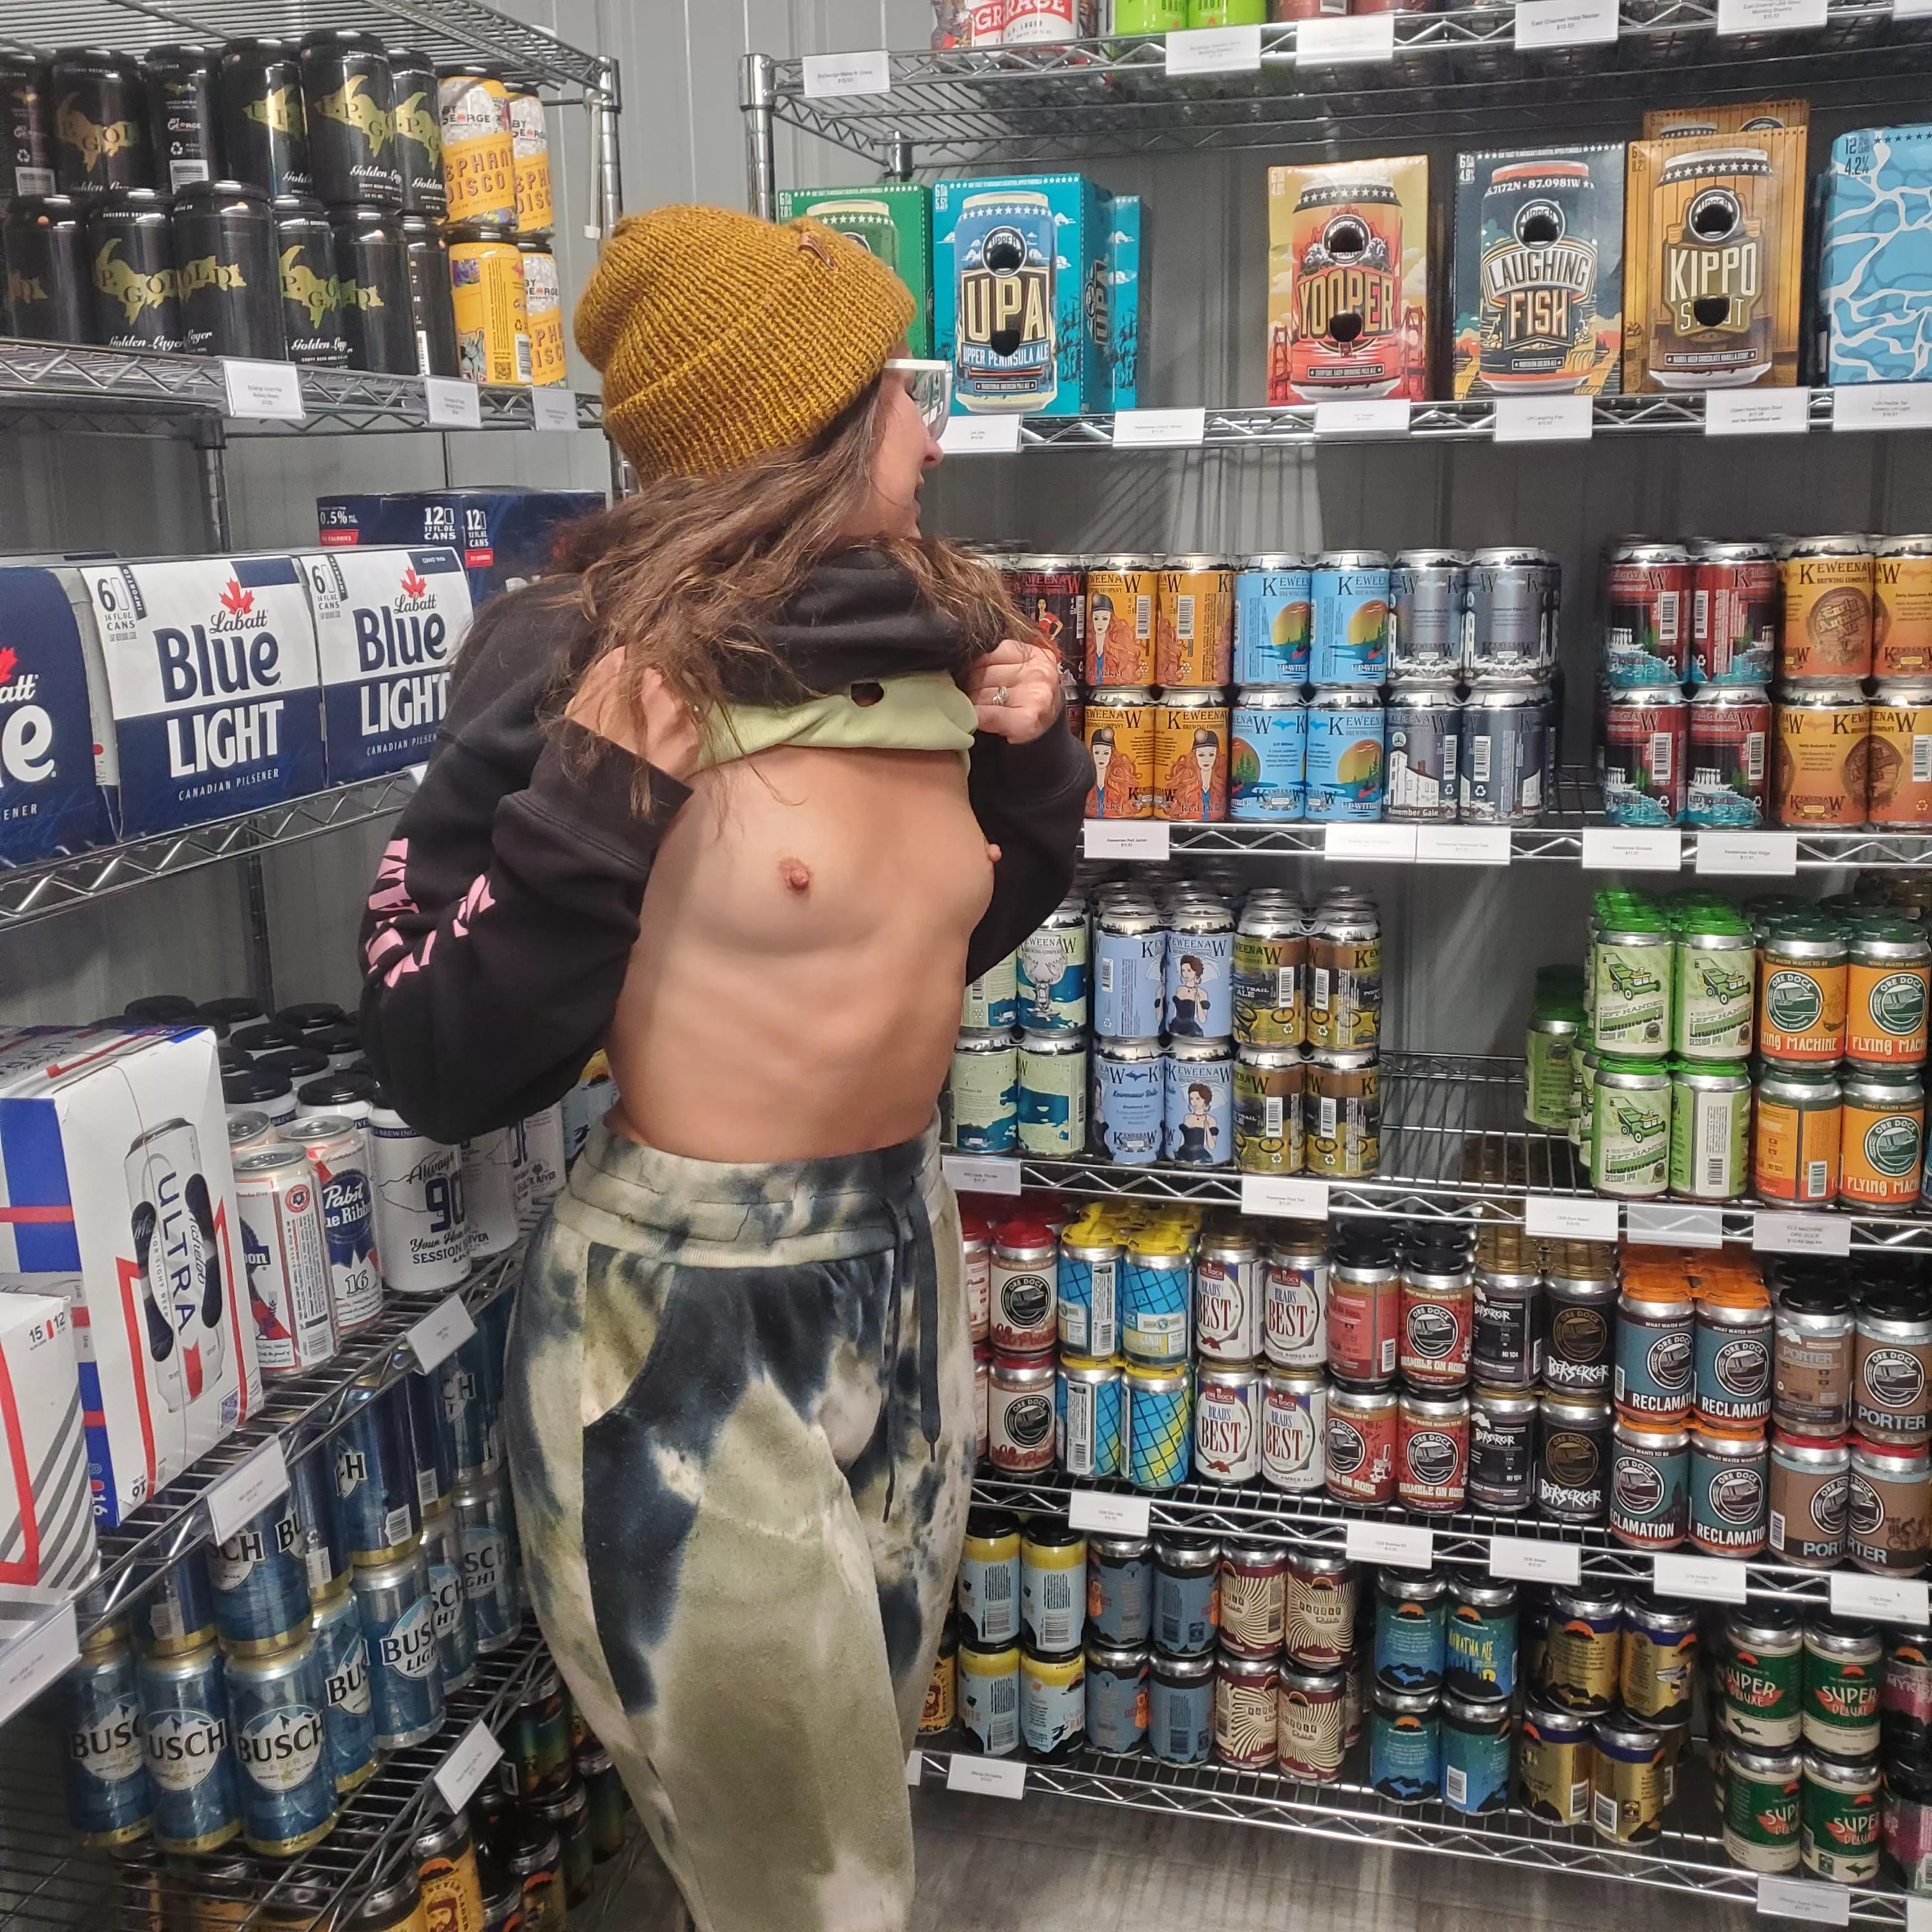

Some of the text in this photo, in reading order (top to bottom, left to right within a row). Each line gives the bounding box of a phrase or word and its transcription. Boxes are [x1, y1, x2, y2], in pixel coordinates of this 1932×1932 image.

[1632, 146, 1637, 158] 6
[1846, 137, 1857, 154] 12
[1460, 155, 1465, 168] 6
[1845, 157, 1869, 175] 4.2%
[350, 165, 387, 176] Golden
[413, 177, 442, 190] Golden
[935, 184, 940, 197] 6
[1528, 179, 1580, 189] 87.0981W
[1488, 250, 1591, 291] LAUGHING
[1670, 243, 1756, 302] KIPPO
[967, 275, 1046, 342] UPA
[1300, 270, 1393, 335] YOOPER
[1510, 289, 1567, 341] FISH
[291, 338, 330, 351] Golden
[963, 344, 1049, 368] UPPER PENINSULA ALE
[424, 507, 444, 526] 12
[466, 509, 481, 531] 12
[470, 539, 489, 548] CANS
[312, 565, 325, 594] 6
[1799, 563, 1873, 584] KEWEENA
[97, 578, 116, 611] 6
[319, 601, 339, 610] CANS
[394, 593, 436, 614] Labatt
[107, 620, 135, 631] CANS
[209, 610, 268, 633] Labatt
[353, 606, 447, 673] Blue
[153, 624, 281, 703] Blue
[360, 673, 450, 737] LIGHT
[1168, 710, 1228, 730] KEWEENA
[167, 700, 284, 779] LIGHT
[366, 740, 408, 758] CANADIAN
[178, 768, 280, 801] CANADIAN PILSENER
[1181, 804, 1200, 813] Red
[1388, 808, 1439, 816] November Gale
[1772, 975, 1814, 990] ORE DOCK
[1881, 977, 1922, 991] ORE DOCK
[1236, 989, 1255, 998] ALE
[1623, 1000, 1664, 1015] HANDED
[1617, 1030, 1625, 1039] IPA
[1712, 1036, 1721, 1045] IPA
[1787, 1037, 1837, 1051] MACHINE
[1853, 1036, 1892, 1055] FLYING
[1168, 1064, 1231, 1083] KEWEENAW
[1876, 1120, 1916, 1134] ORE DOCK
[537, 1171, 556, 1183] RIVER
[1627, 1172, 1636, 1180] IPA
[323, 1181, 364, 1209] Pabst
[1848, 1176, 1887, 1197] FLYING
[425, 1170, 465, 1233] 90
[326, 1202, 370, 1228] ue Ribb
[158, 1171, 196, 1336] ULTRA
[410, 1238, 440, 1252] Your
[155, 1258, 164, 1289] LIGHT
[345, 1270, 369, 1295] 16
[1009, 1278, 1044, 1290] ORE DOCK
[1197, 1292, 1231, 1330] BEST
[1268, 1298, 1307, 1338] BEST
[1413, 1307, 1450, 1320] ORE DOCK
[1561, 1312, 1574, 1321] ORE
[54, 1312, 65, 1328] 12
[29, 1326, 43, 1343] 15
[1657, 1338, 1673, 1351] ORE
[1724, 1342, 1765, 1357] ORE DOCK
[1784, 1348, 1833, 1365] PORTER
[1871, 1352, 1916, 1367] ORE DOCK
[1434, 1361, 1446, 1370] ON
[1547, 1356, 1609, 1383] BERSERKER
[1216, 1388, 1234, 1402] DOCK
[1013, 1399, 1025, 1411] ORE
[1702, 1397, 1771, 1418] RECLAMATIO
[1858, 1406, 1927, 1430] PORTER
[1202, 1416, 1241, 1453] BEST
[1337, 1422, 1356, 1438] DOCK
[1266, 1421, 1303, 1461] BEST
[1414, 1435, 1452, 1447] ORE DOCK
[1553, 1435, 1565, 1448] ORE
[1618, 1459, 1655, 1476] ORE DOCK
[1343, 1475, 1376, 1494] ON ROSE
[1718, 1471, 1758, 1486] ORE DOCK
[1436, 1487, 1446, 1496] ON
[1540, 1478, 1602, 1508] BERSERKER
[1821, 1483, 1836, 1496] ORE
[93, 1496, 108, 1517] 16
[1611, 1507, 1675, 1538] ECLAMATION
[1696, 1522, 1765, 1546] RECLAMATIO
[1803, 1542, 1844, 1556] PORT
[1728, 1668, 1775, 1698] SUPER
[1822, 1686, 1876, 1703] SUPER
[1832, 1705, 1868, 1715] DELUXE
[149, 1719, 226, 1761] USCH
[237, 1715, 324, 1763] BUSCH
